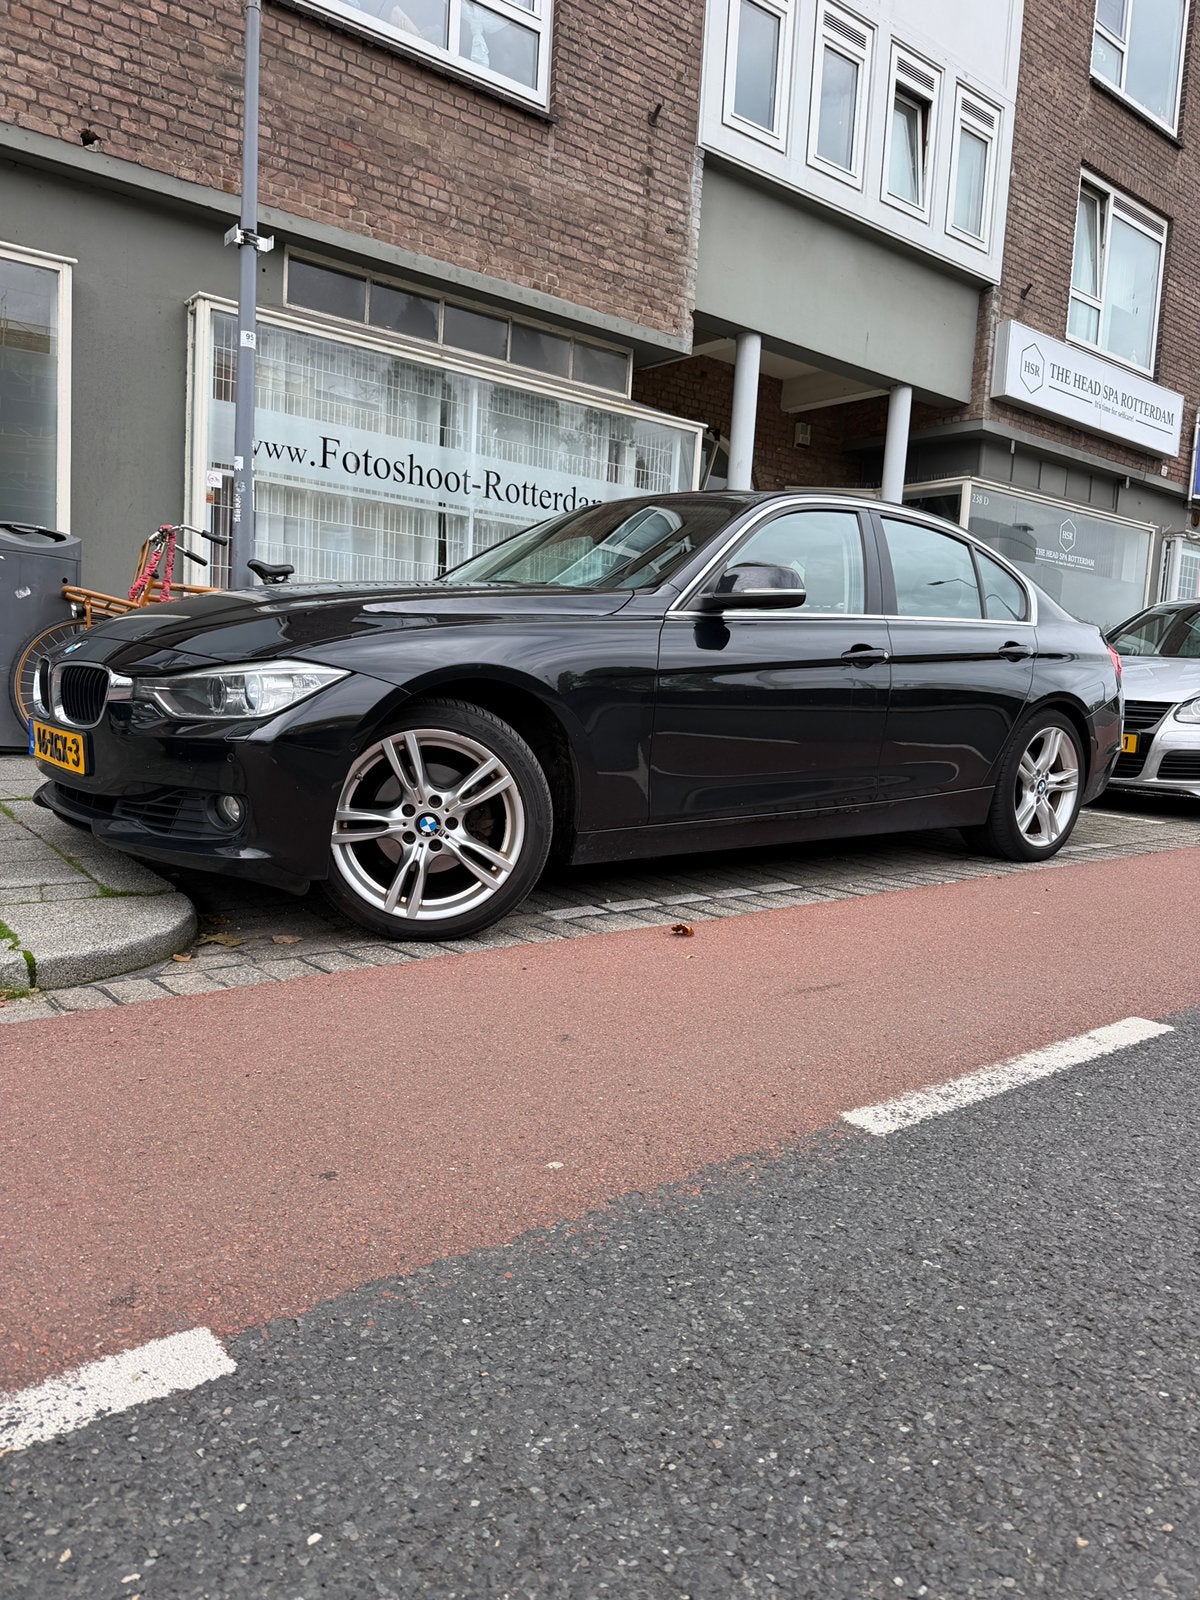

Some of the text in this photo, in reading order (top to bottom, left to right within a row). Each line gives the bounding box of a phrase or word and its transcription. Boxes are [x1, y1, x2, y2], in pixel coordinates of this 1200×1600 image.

[245, 333, 255, 341] 95
[1024, 360, 1040, 377] HSR
[1050, 363, 1175, 426] THE HEAD SPA ROTTERDAM
[983, 496, 990, 506] D
[1062, 530, 1073, 541] HSR
[1068, 554, 1095, 567] ROTTERDAM
